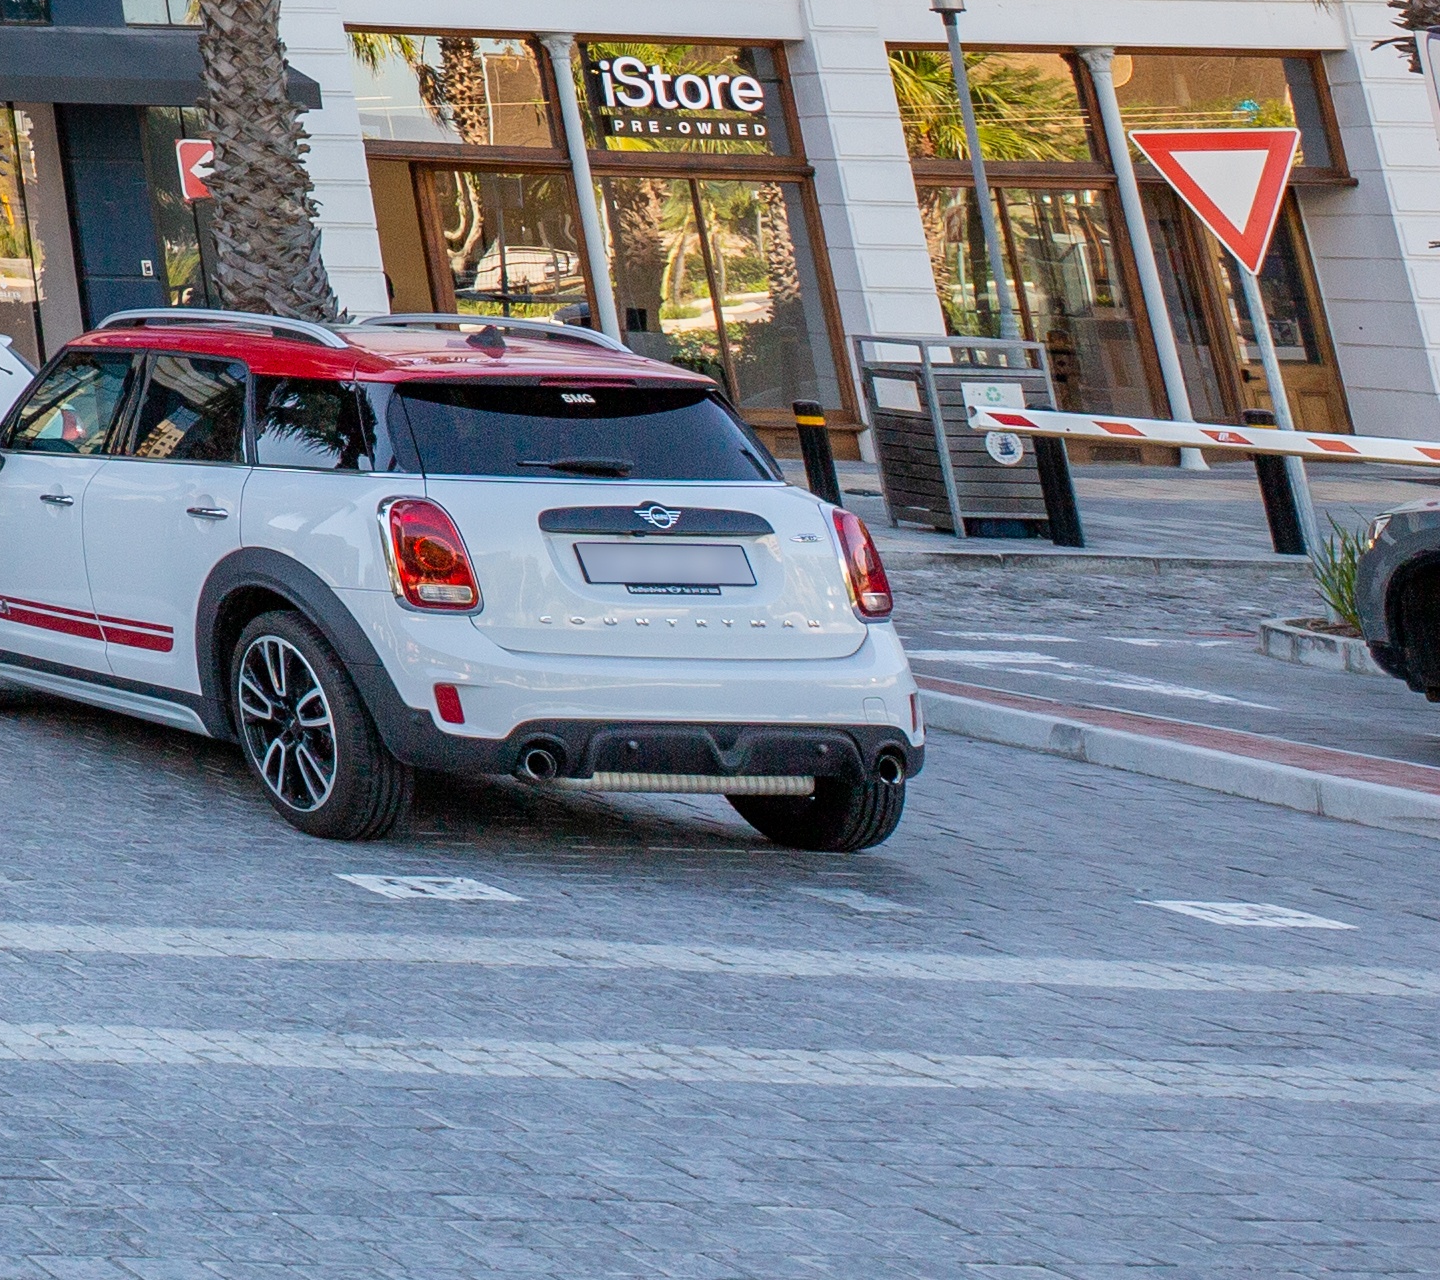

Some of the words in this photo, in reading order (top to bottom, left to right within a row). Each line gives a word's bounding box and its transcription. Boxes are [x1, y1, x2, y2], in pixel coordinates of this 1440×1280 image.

[599, 56, 765, 112] iStore
[613, 119, 767, 137] PRE-OWNED
[560, 393, 596, 403] SMG
[539, 615, 821, 629] COUNTRYMAN
